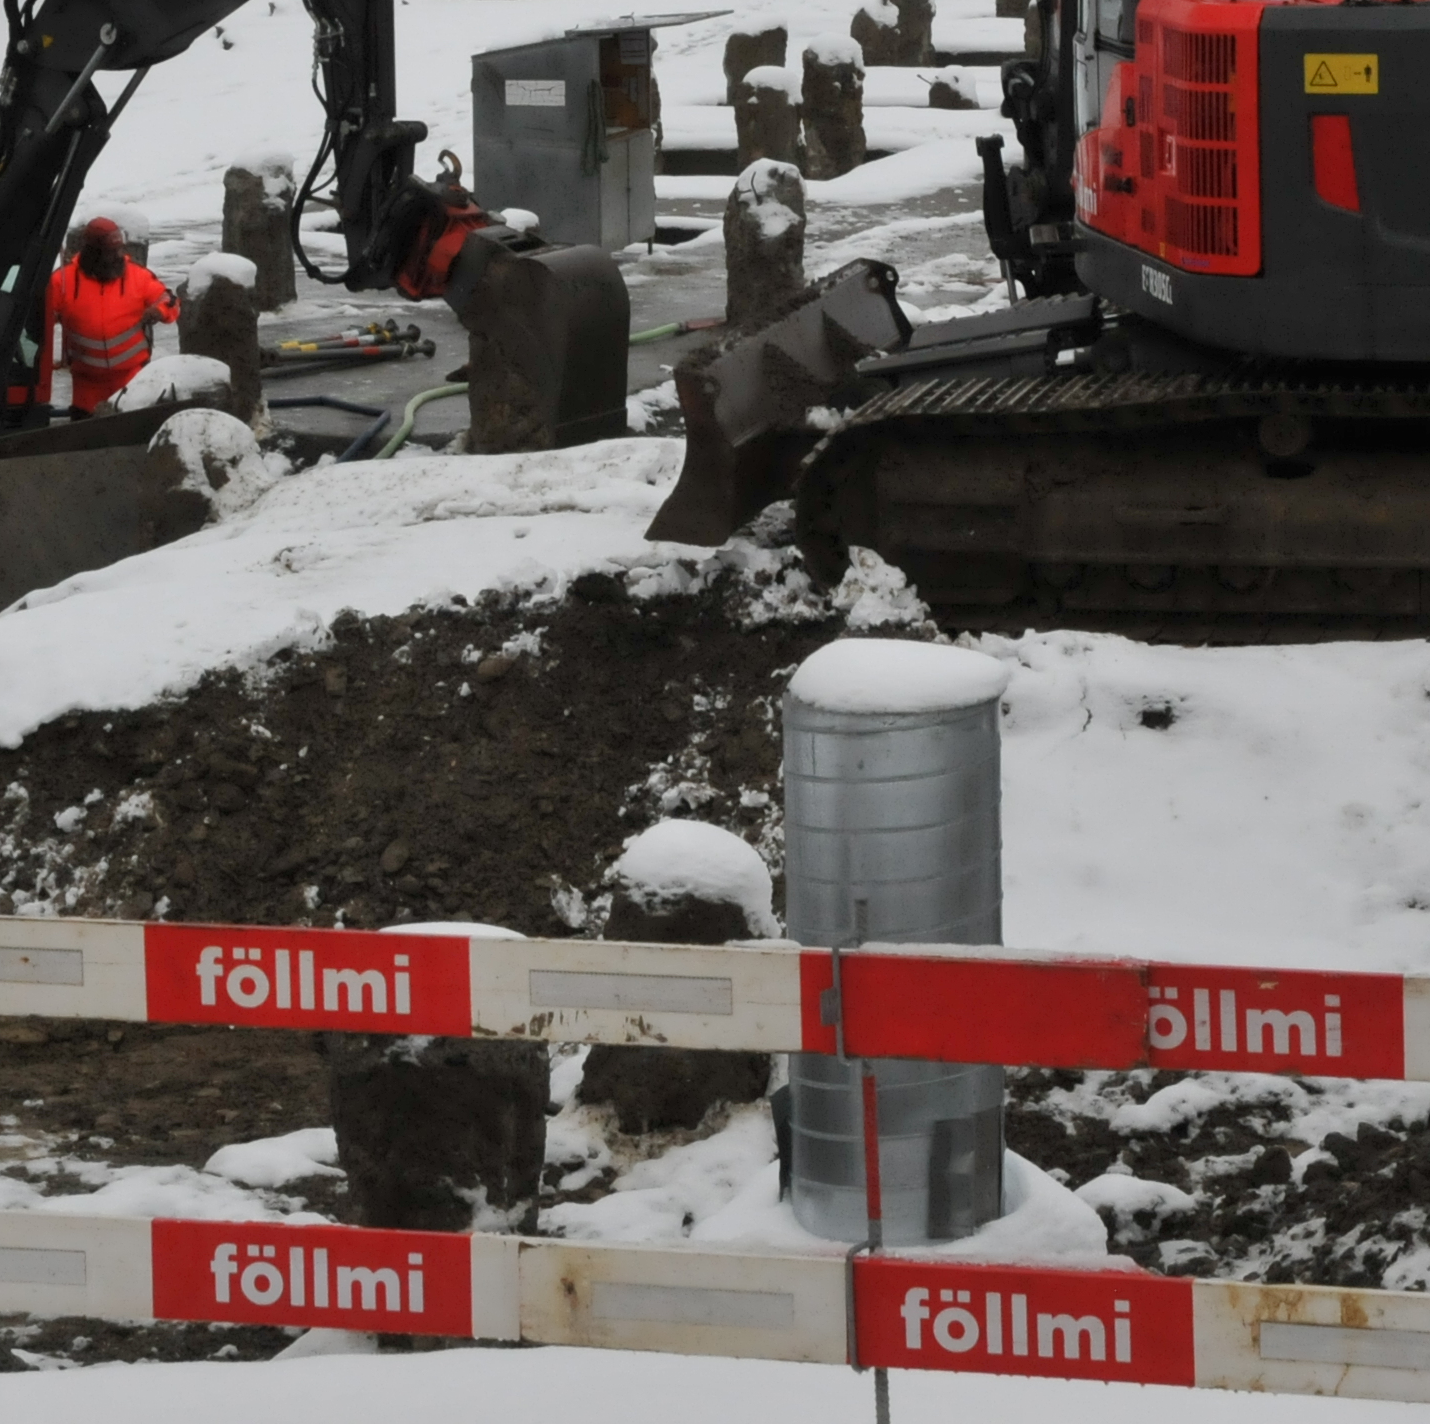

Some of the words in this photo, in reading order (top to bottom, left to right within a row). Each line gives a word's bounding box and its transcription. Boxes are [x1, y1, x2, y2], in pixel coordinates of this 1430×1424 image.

[196, 946, 411, 1014] föllmi
[1149, 987, 1342, 1057] öllmi
[211, 1242, 425, 1313] föllmi
[901, 1287, 1132, 1363] föllmi
